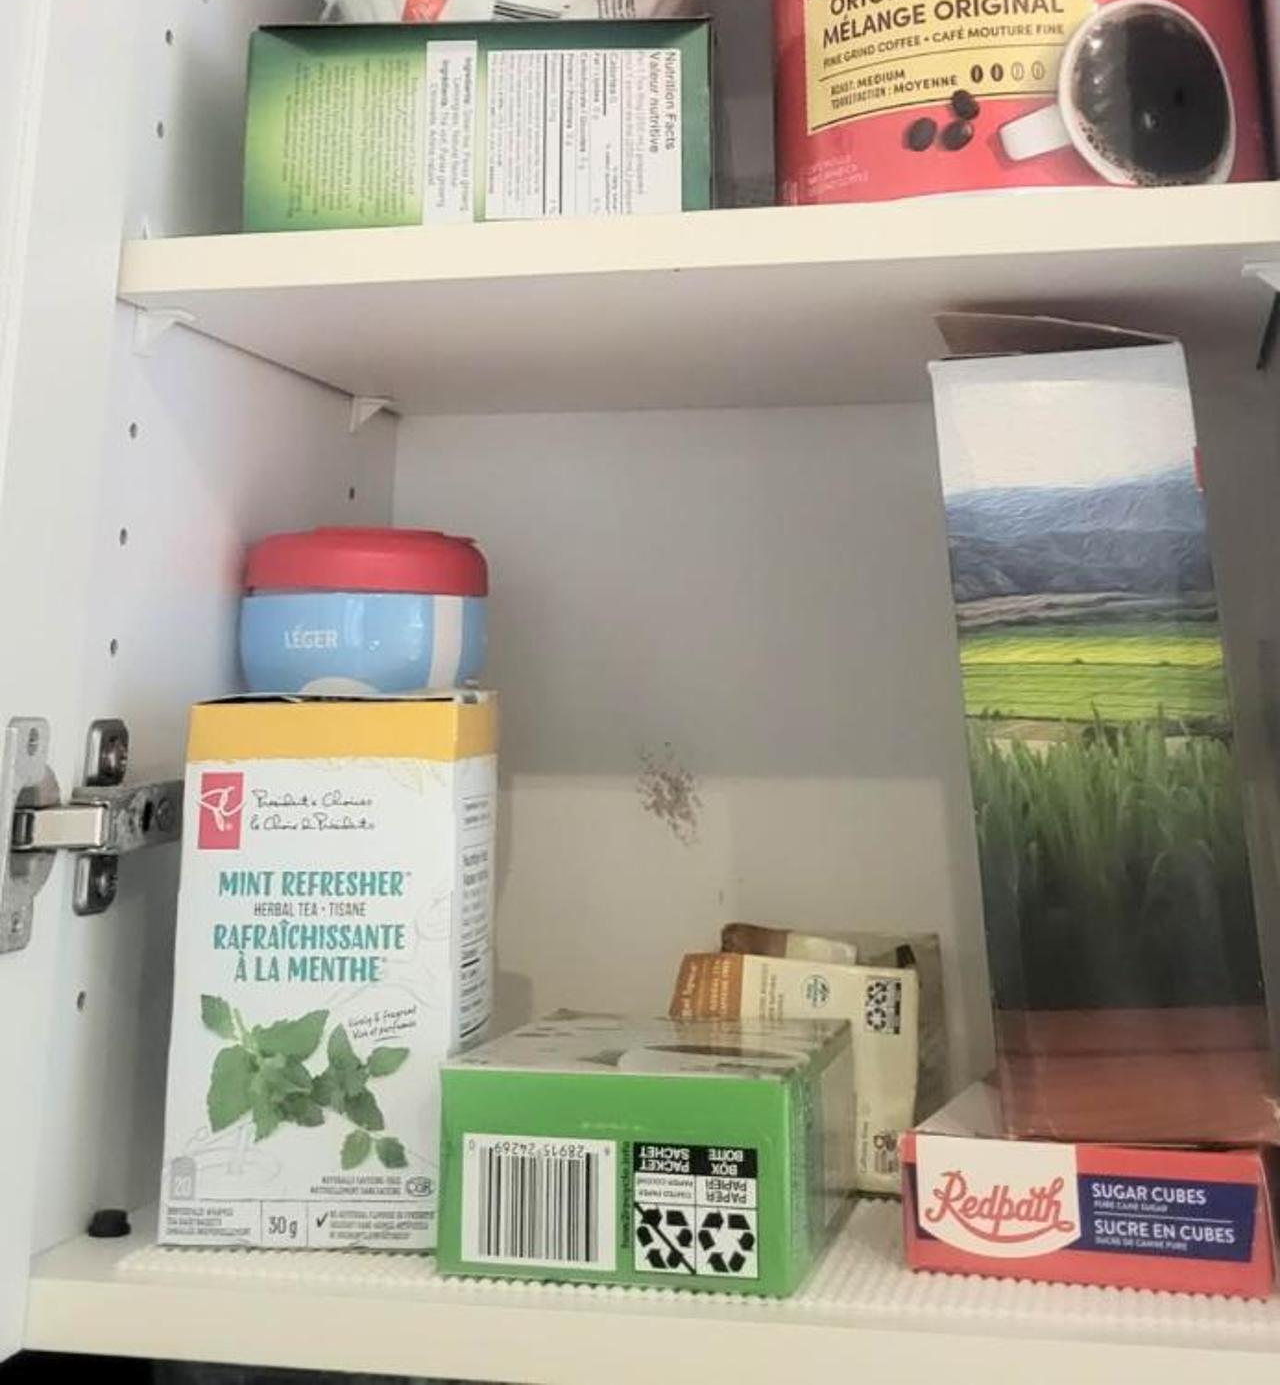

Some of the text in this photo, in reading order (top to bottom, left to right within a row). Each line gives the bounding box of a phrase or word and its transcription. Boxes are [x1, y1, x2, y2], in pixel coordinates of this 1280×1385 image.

[823, 3, 927, 48] MÉLANGE
[823, 23, 1064, 70] FINE GRIND COFFEE CAFÉ MOUTURE FINE
[857, 69, 906, 88] MEDIUM
[893, 74, 957, 93] MOYENNE
[649, 51, 660, 153] Valeur nutritive
[665, 51, 676, 150] Nutrition Facts
[284, 625, 339, 649] LÉGER
[218, 871, 404, 896] MINT REFRESHER
[254, 902, 367, 917] HERBAL TEA TISANE
[213, 919, 405, 950] RAFRAÎCHISSANTE
[234, 950, 381, 982] À LA MENTHE
[495, 1142, 536, 1156] 24269
[543, 1144, 585, 1158] 28915
[639, 1146, 690, 1160] SACHET
[639, 1159, 690, 1173] PACKET
[711, 1162, 738, 1175] BOX
[705, 1176, 747, 1191] PAPIER
[1092, 1182, 1207, 1205] SUGAR CUBES
[706, 1190, 747, 1204] PAPER
[926, 1170, 1076, 1243] Redpath
[1141, 1203, 1168, 1212] SUGAR
[268, 1215, 287, 1235] 30
[289, 1220, 298, 1239] g
[1094, 1219, 1236, 1244] SUCRE EN CUBES
[1124, 1238, 1133, 1247] DE
